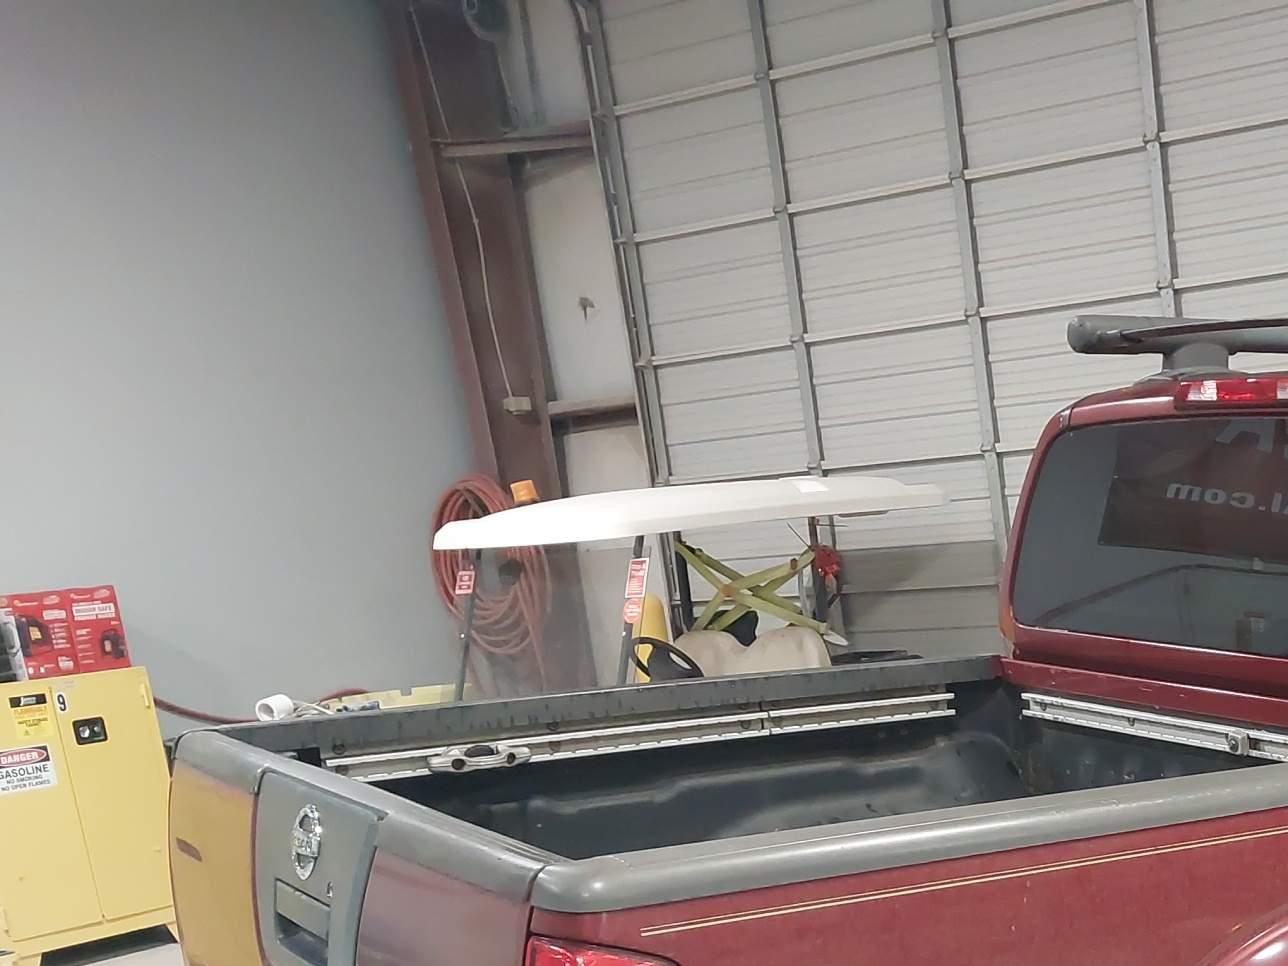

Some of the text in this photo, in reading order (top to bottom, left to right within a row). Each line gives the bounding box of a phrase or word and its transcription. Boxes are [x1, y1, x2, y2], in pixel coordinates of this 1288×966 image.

[57, 694, 67, 711] 9
[0, 751, 39, 765] DANGER
[0, 764, 49, 780] GASOLINE
